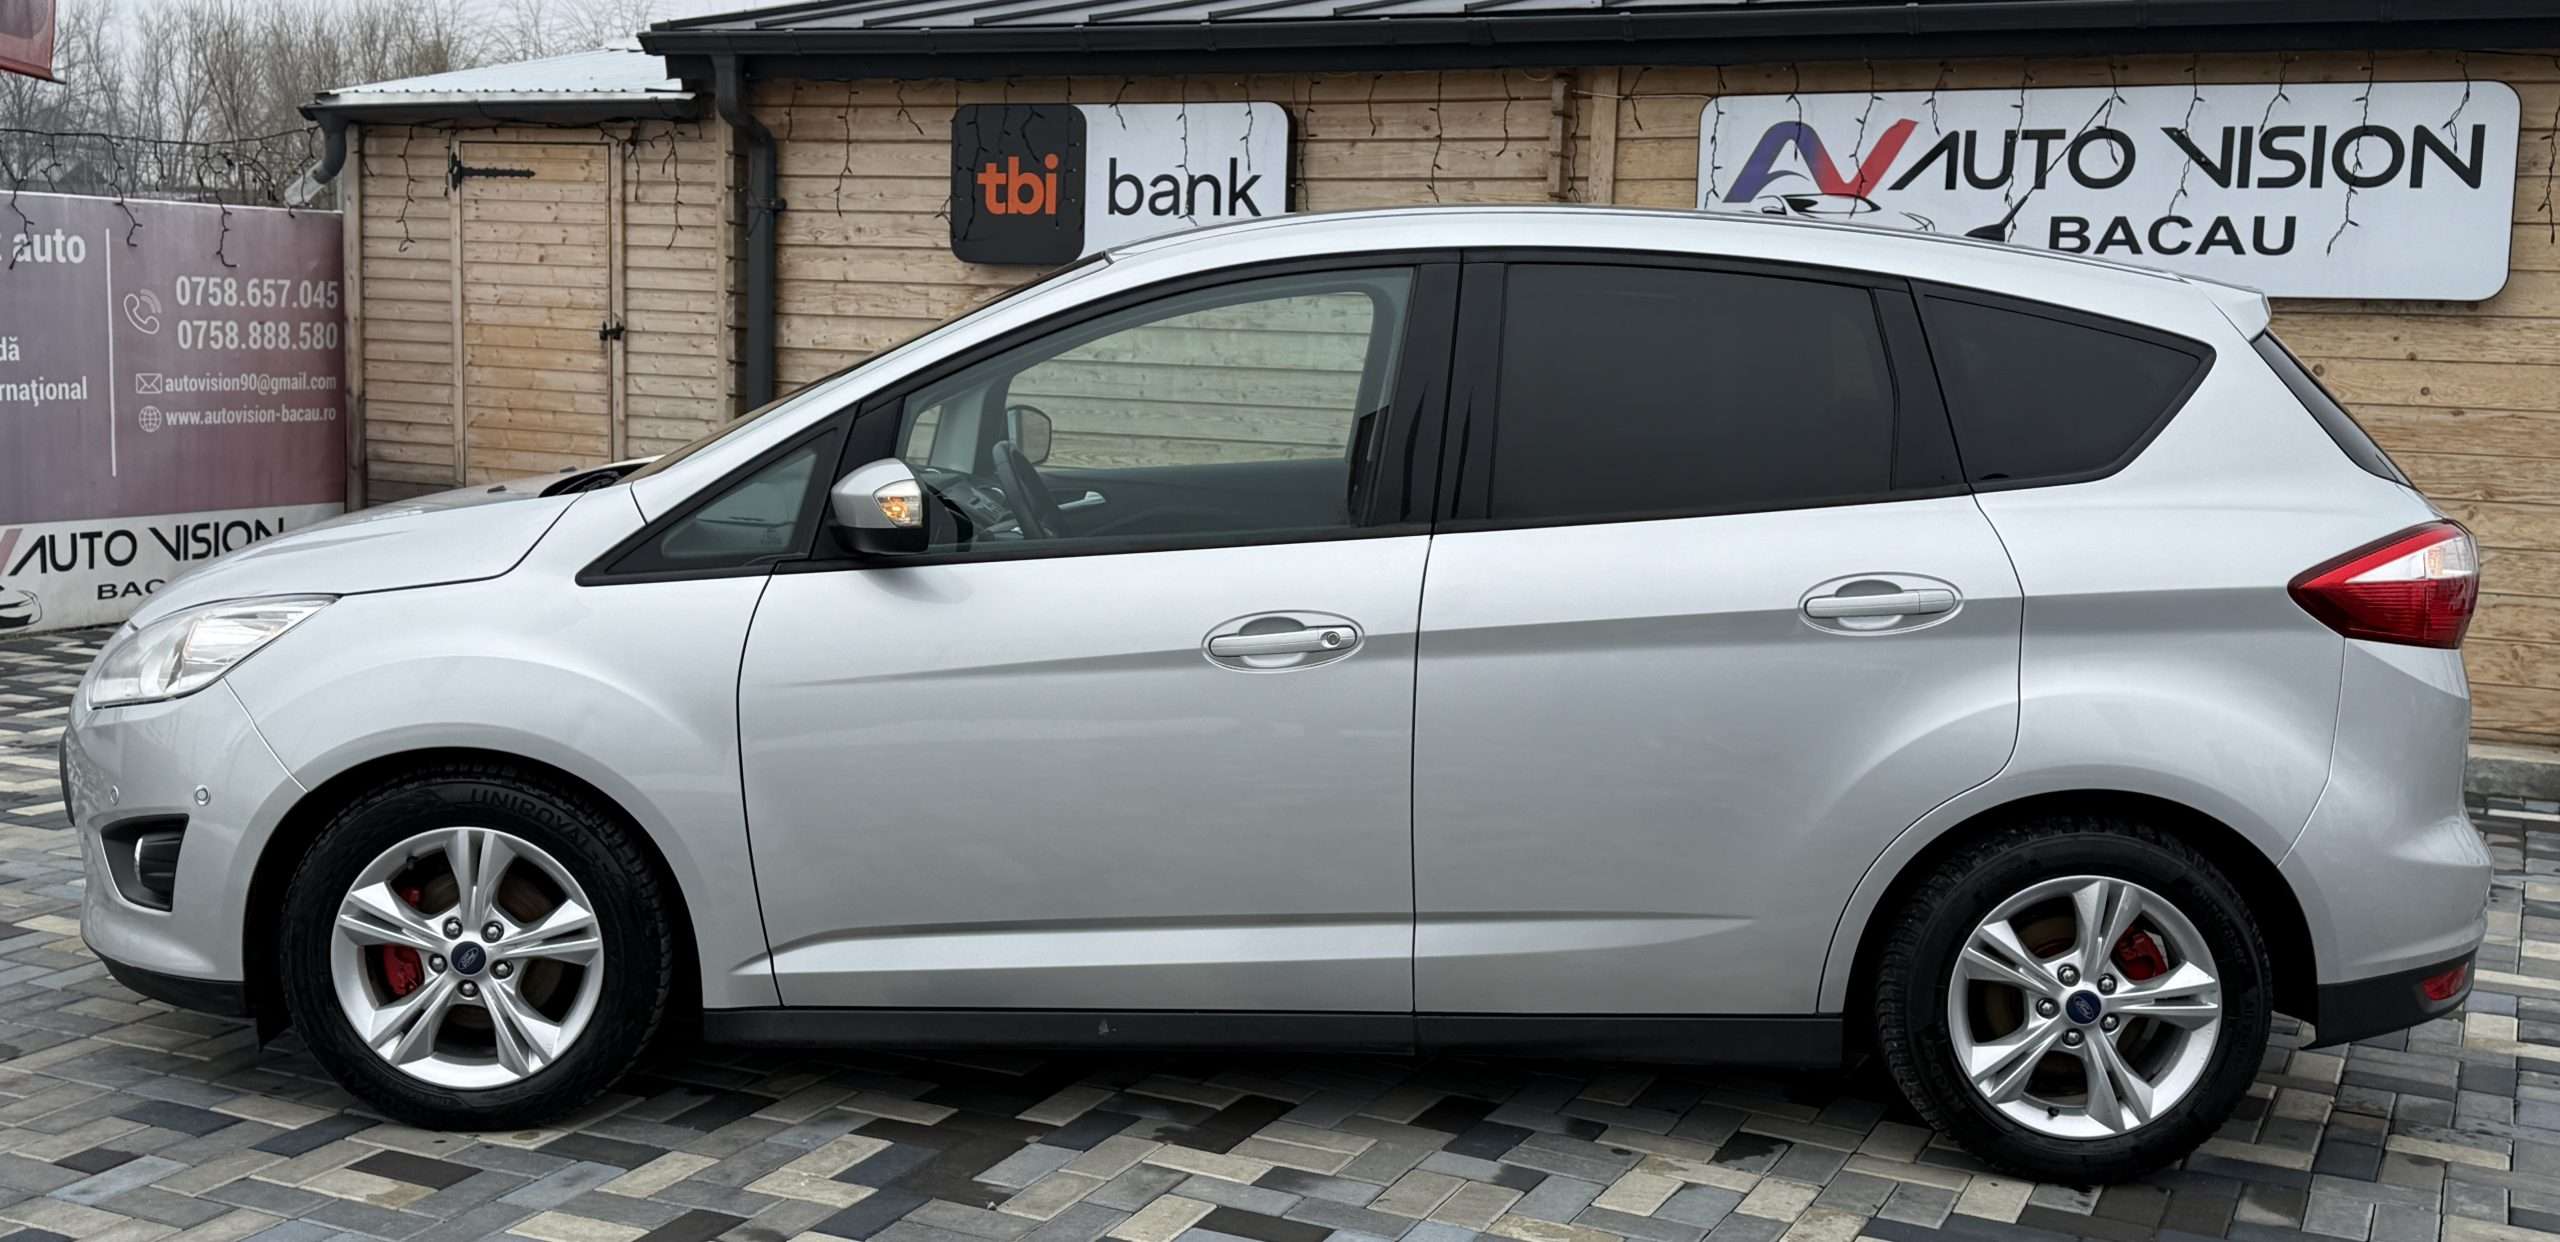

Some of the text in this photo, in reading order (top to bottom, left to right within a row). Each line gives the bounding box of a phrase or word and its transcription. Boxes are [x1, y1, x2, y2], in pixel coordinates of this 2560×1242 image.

[1887, 126, 2136, 191] AUTO
[2160, 124, 2486, 189] VISION
[977, 153, 1262, 217] tbi bank
[12, 228, 86, 264] auto
[2049, 215, 2296, 256] BACAU
[176, 276, 338, 309] 0758.657.045
[178, 320, 338, 350] 0758.888.580
[165, 371, 337, 396] autovision90@gmail.com
[166, 403, 337, 426] www.autovision-bacau.ro
[8, 529, 138, 576] AUTO
[97, 579, 166, 600] BAC
